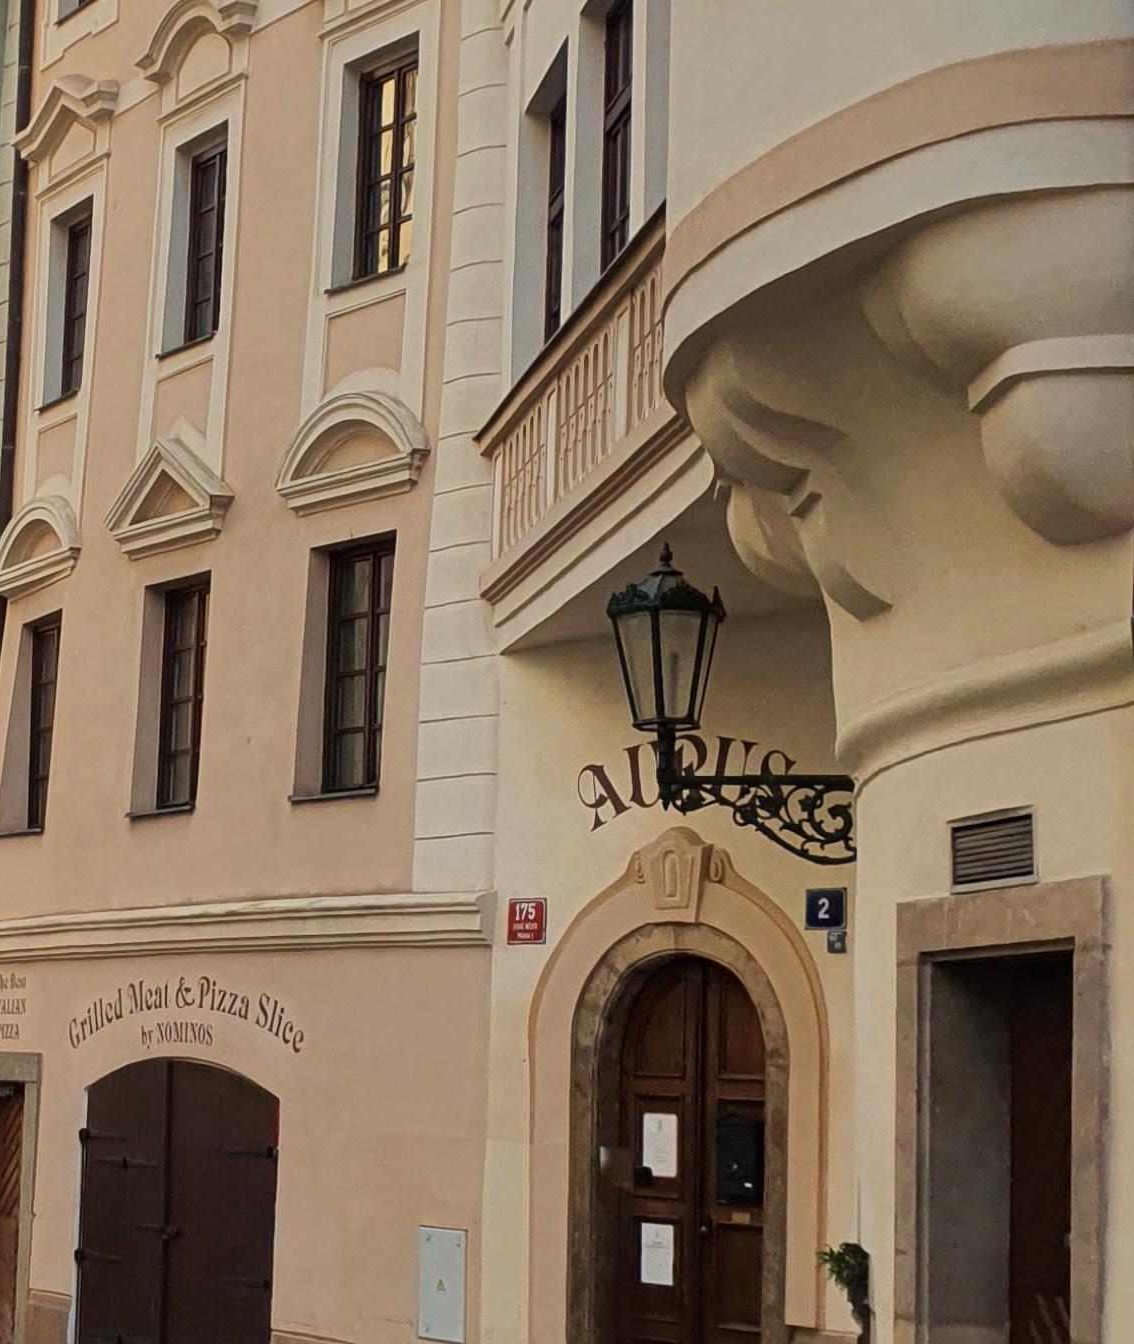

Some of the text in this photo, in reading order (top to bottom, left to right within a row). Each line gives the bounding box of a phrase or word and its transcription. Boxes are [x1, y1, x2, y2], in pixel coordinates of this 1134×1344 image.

[514, 901, 537, 922] 175
[818, 896, 830, 920] 2
[68, 975, 305, 1054] Grilled Meat & Pizza Slice
[141, 1020, 214, 1050] by NOMINOS
